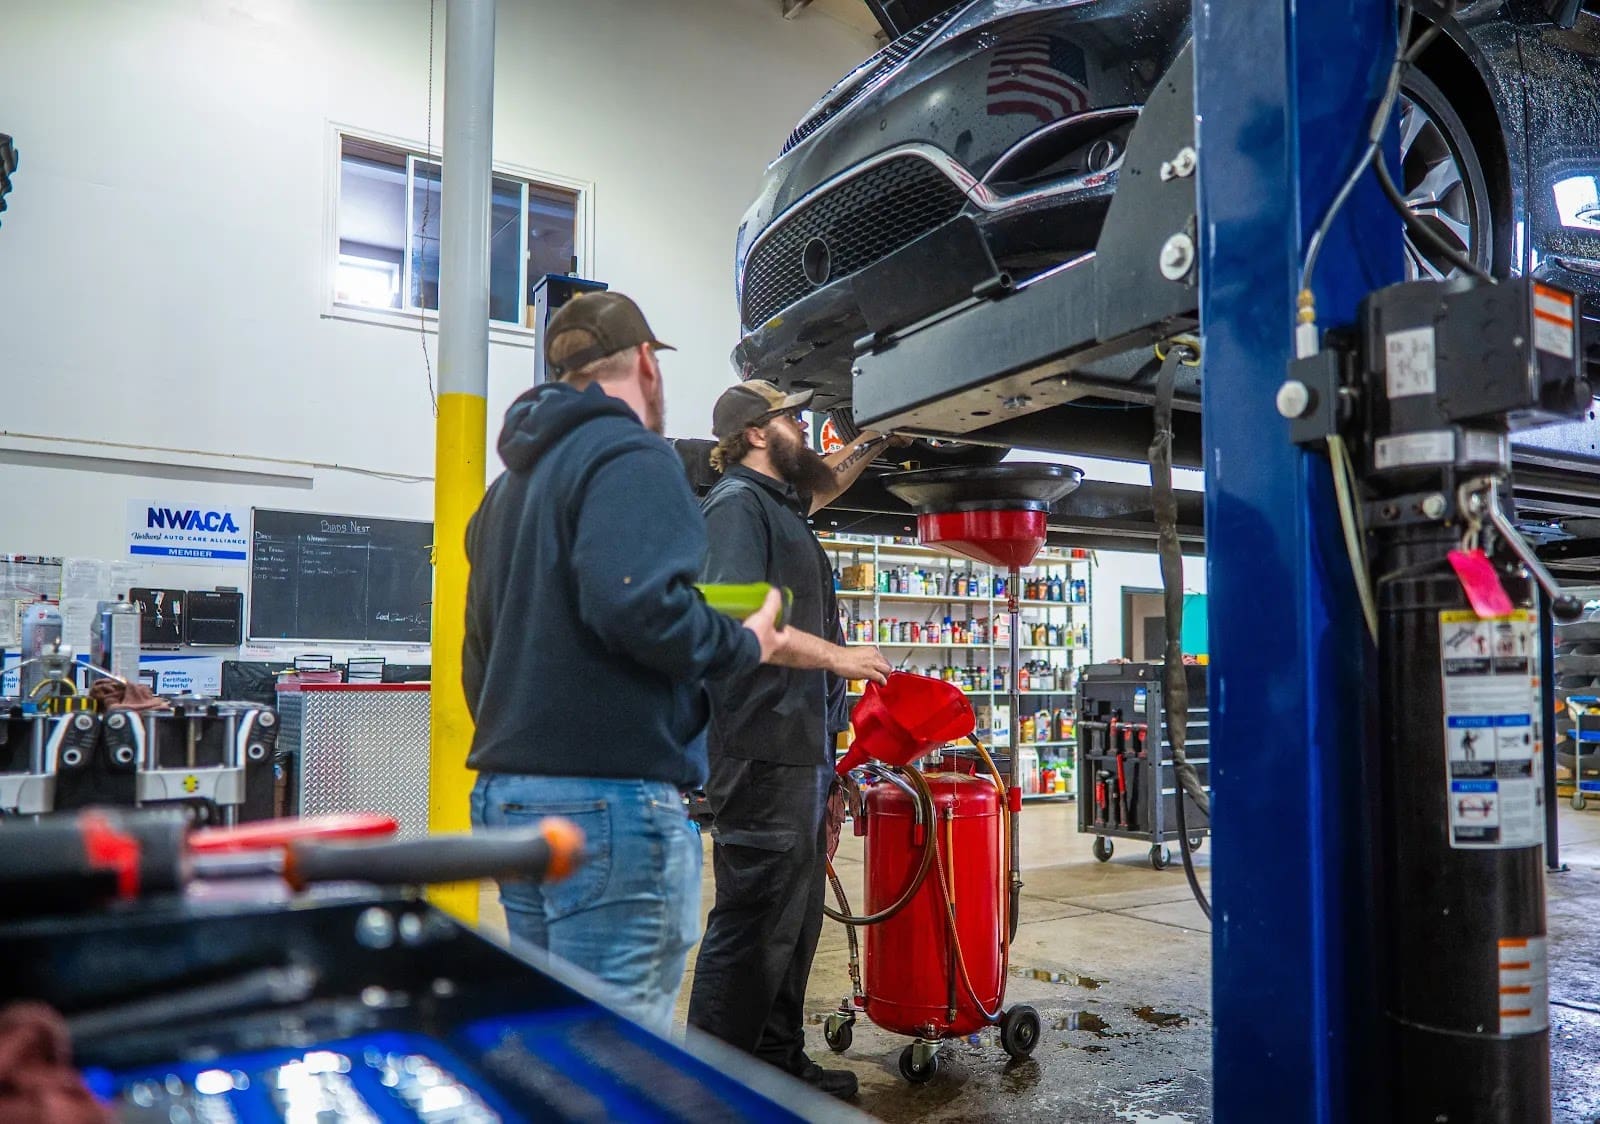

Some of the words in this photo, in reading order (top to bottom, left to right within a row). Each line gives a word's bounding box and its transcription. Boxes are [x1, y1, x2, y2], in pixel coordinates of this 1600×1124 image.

[148, 507, 240, 533] NWACA
[130, 532, 161, 541] Northwest
[169, 548, 213, 558] MEMBER
